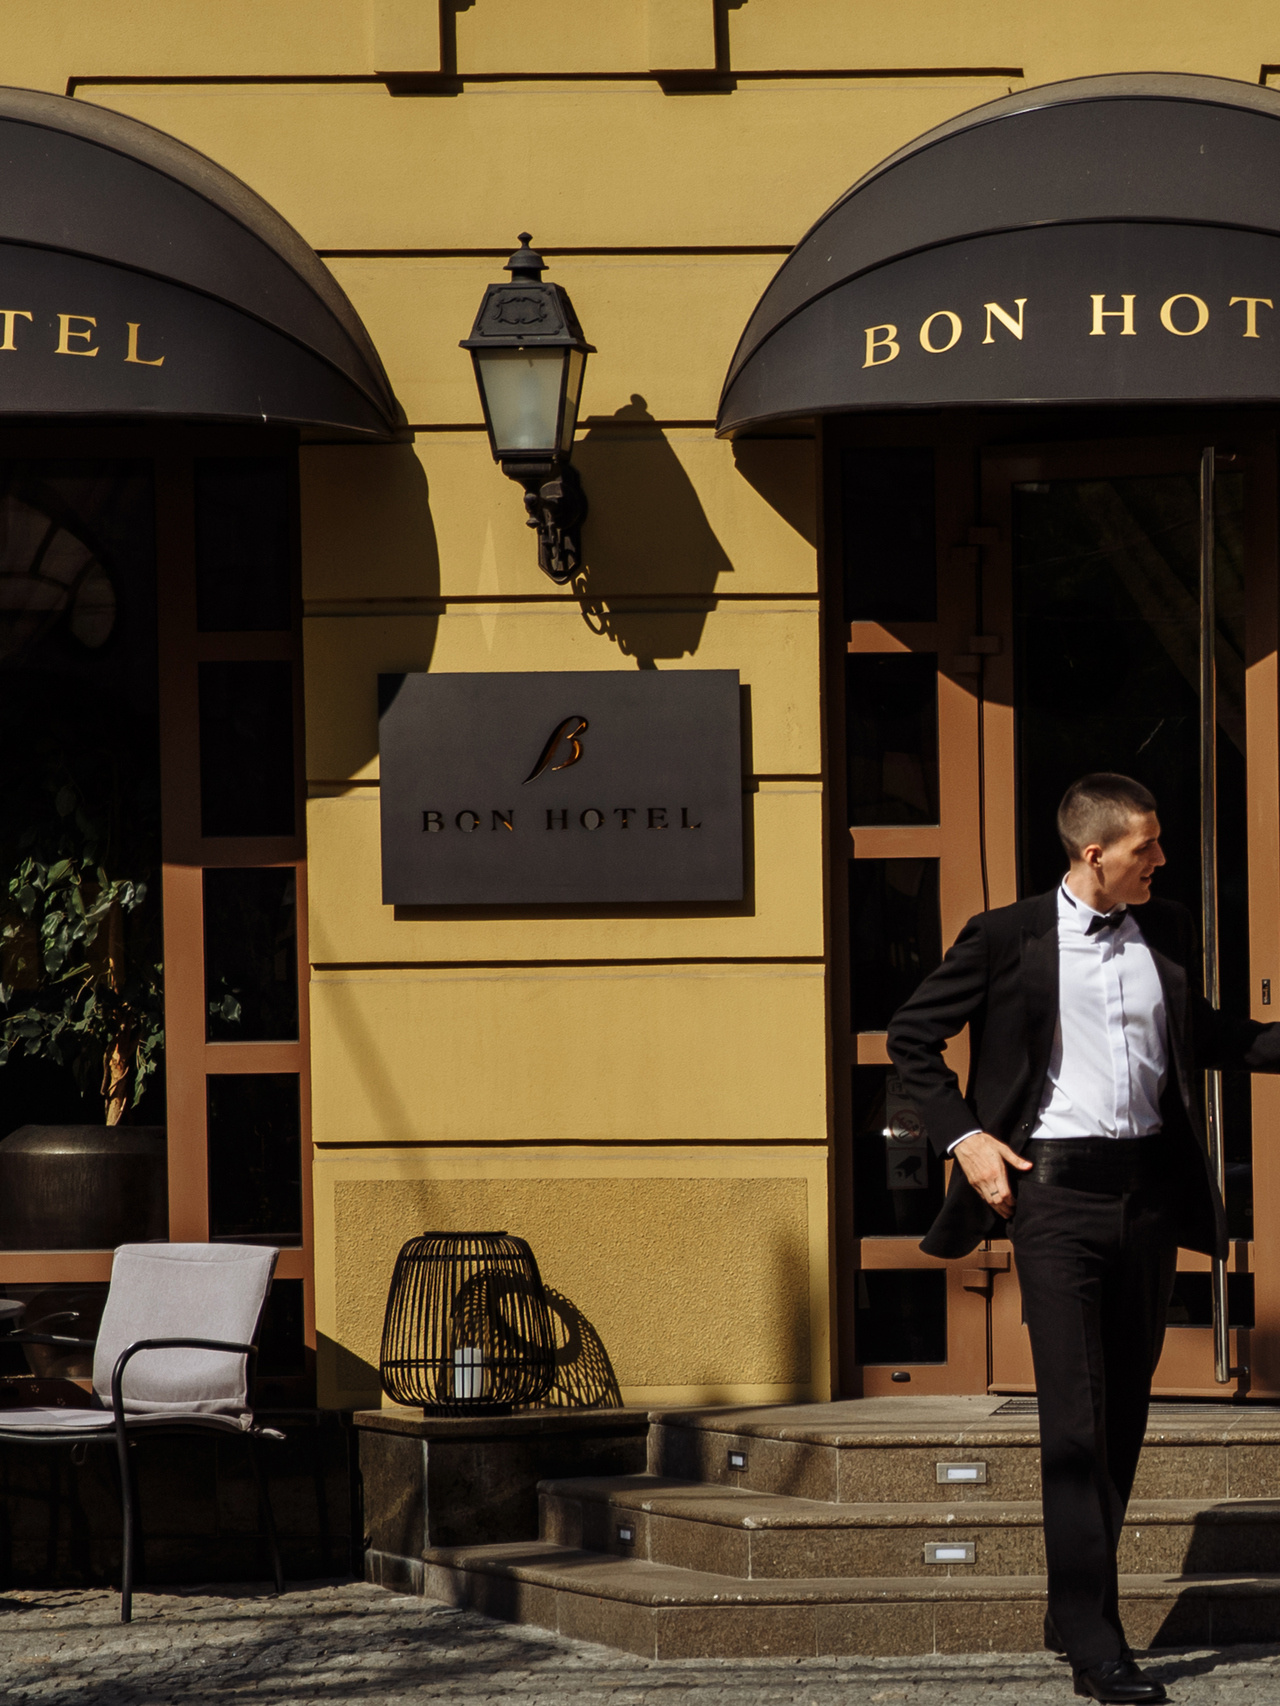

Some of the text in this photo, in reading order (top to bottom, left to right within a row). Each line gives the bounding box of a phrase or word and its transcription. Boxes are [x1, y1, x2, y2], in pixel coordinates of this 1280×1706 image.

[0, 309, 165, 367] TEL
[862, 298, 1027, 368] BON
[422, 807, 702, 832] BON HOTEL
